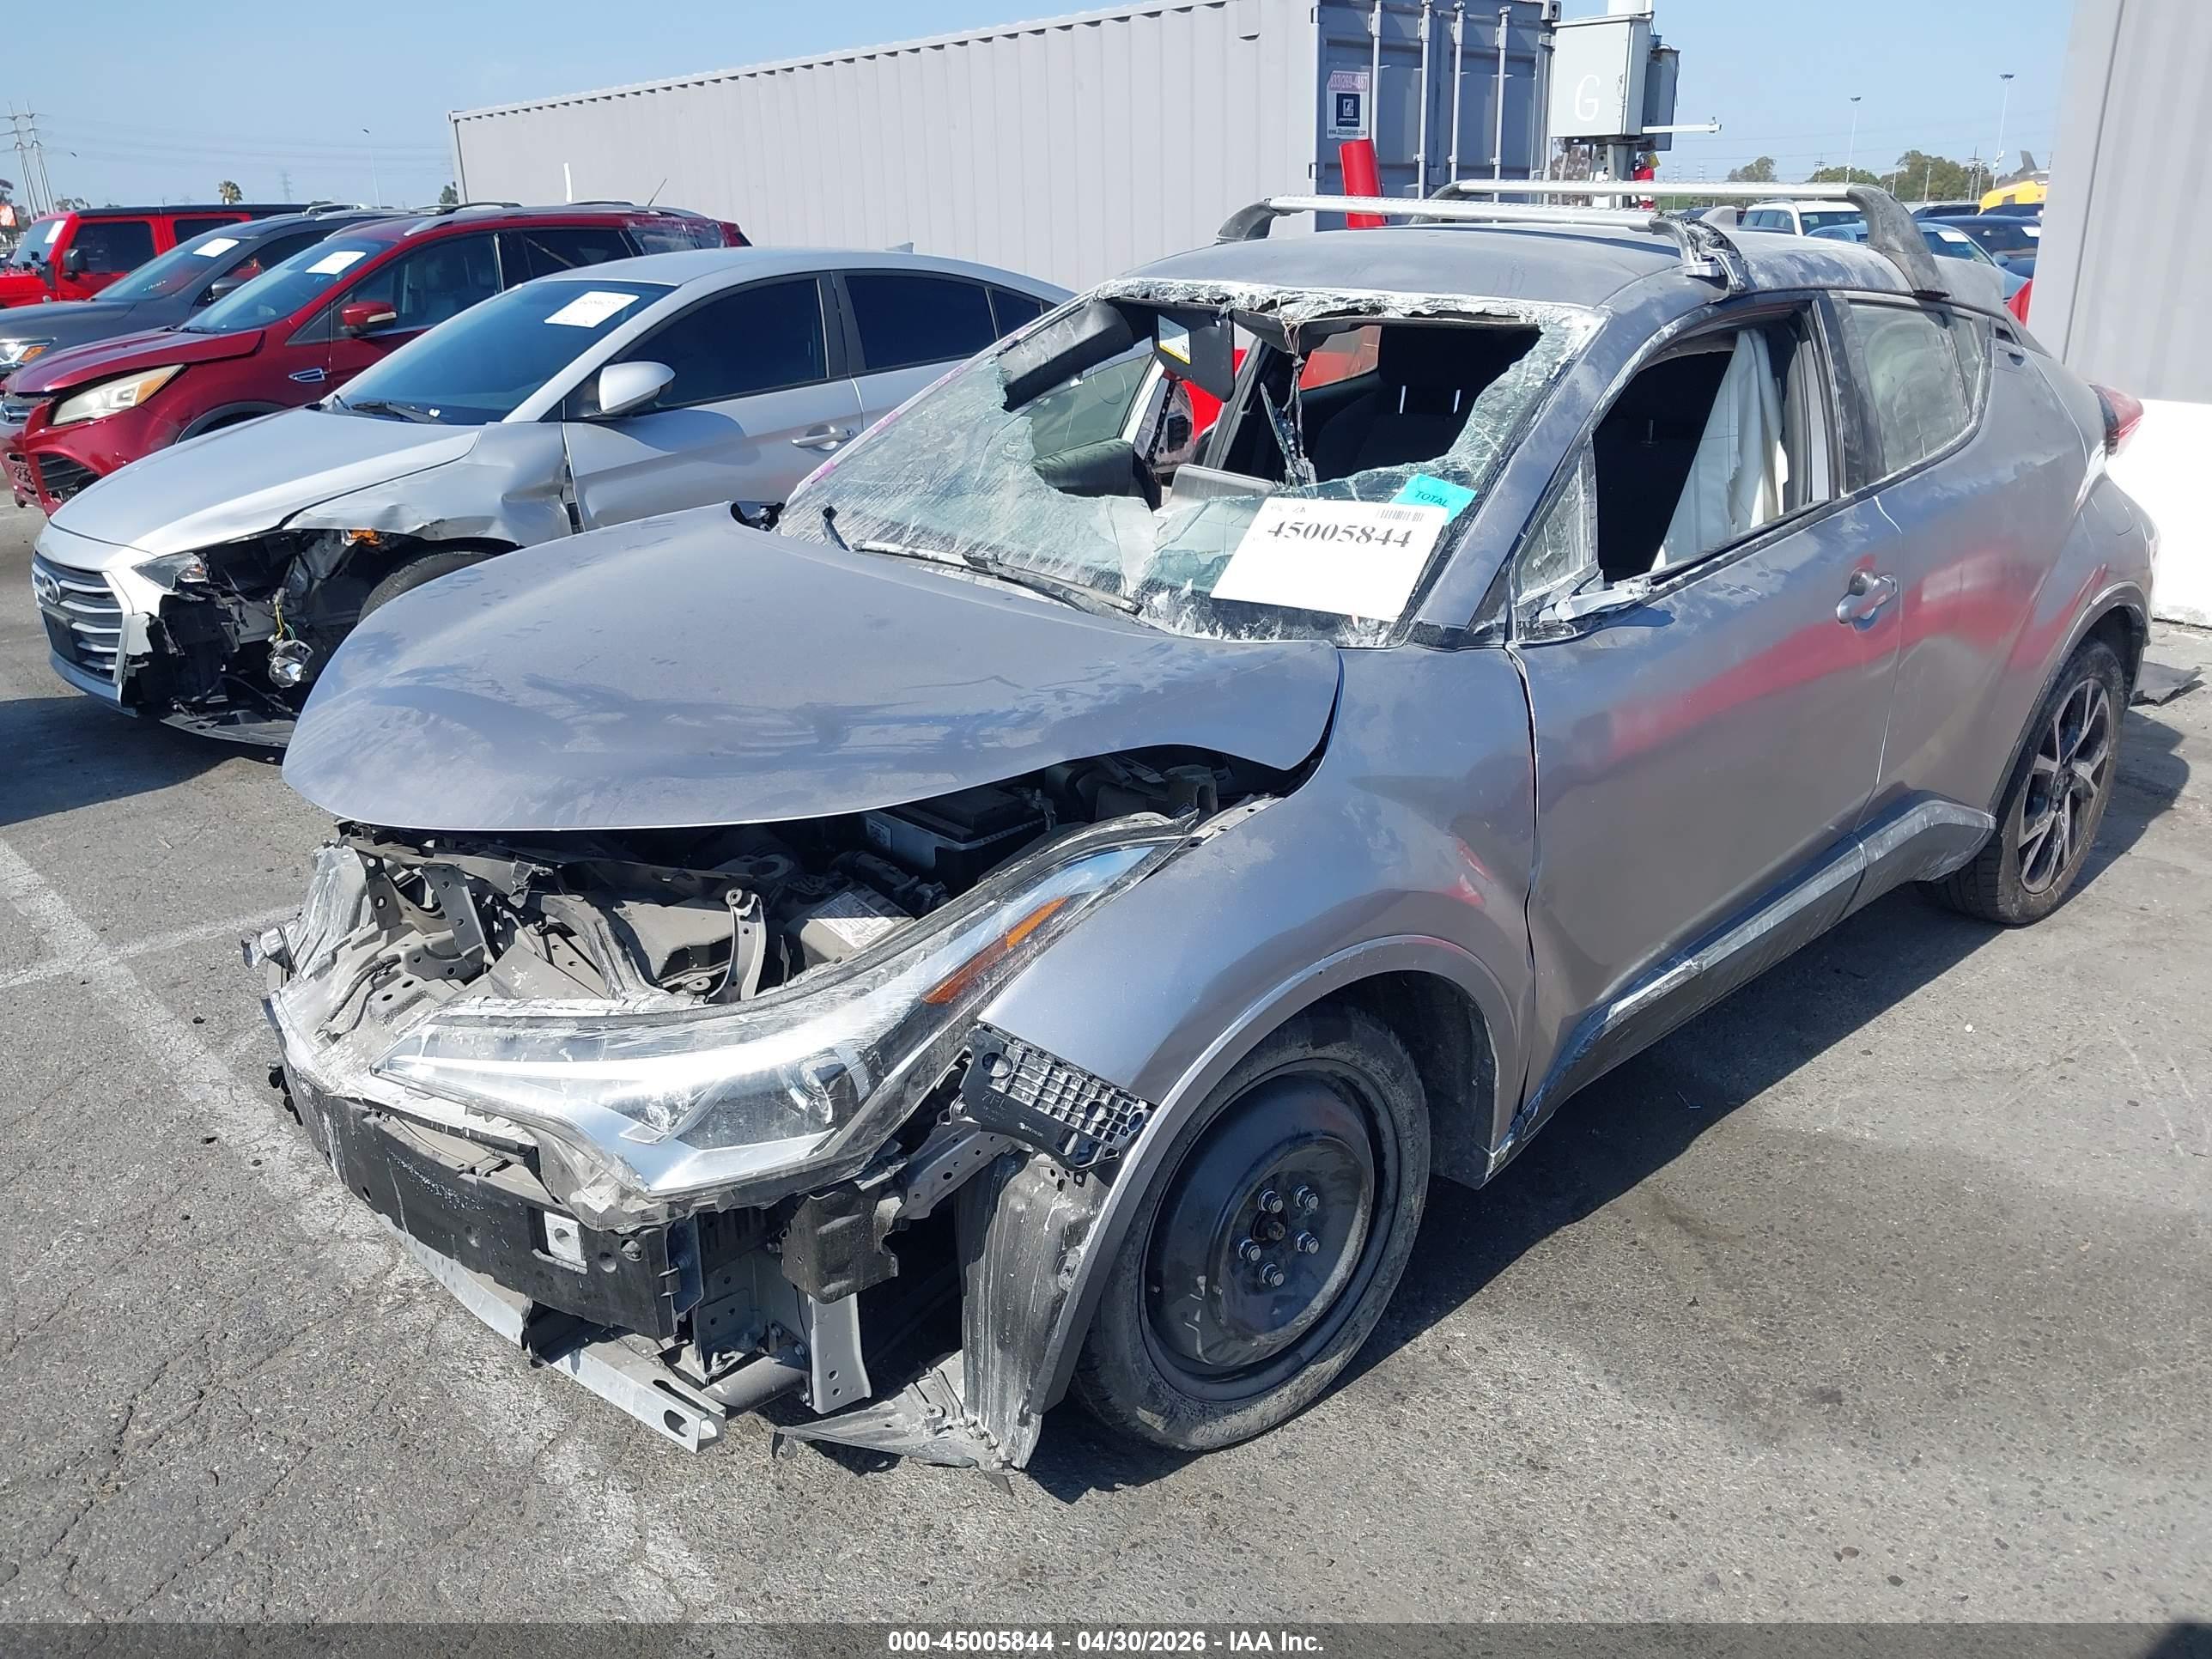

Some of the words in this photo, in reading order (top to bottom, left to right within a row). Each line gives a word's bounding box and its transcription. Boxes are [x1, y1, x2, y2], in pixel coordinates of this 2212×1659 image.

[1575, 75, 1601, 121] G
[1415, 490, 1448, 507] TOTAL
[1267, 521, 1413, 548] 45005844
